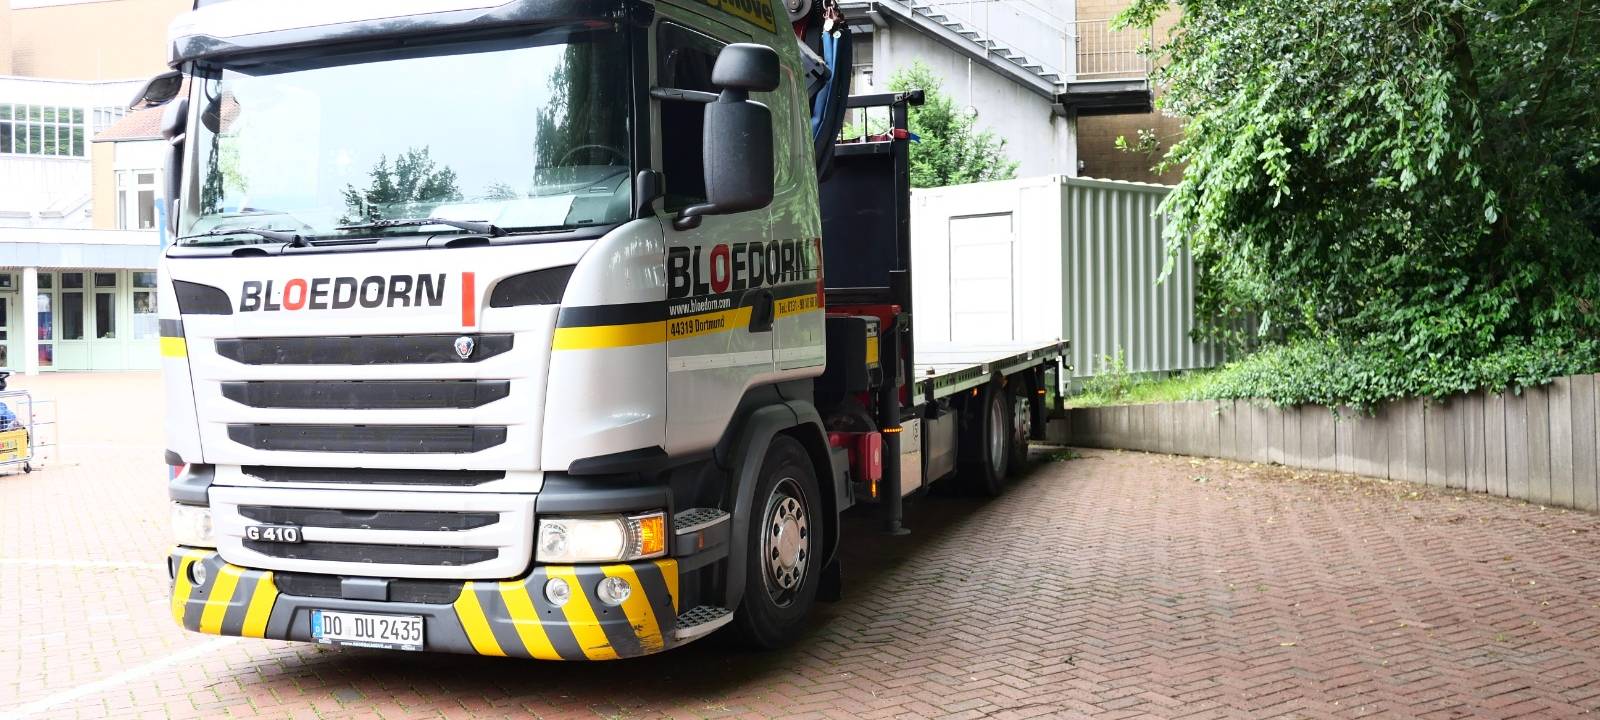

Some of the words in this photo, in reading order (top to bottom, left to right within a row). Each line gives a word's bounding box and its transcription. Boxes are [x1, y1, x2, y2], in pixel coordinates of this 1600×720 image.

[667, 239, 810, 299] BLOEDORN
[239, 273, 447, 312] BLOEDORN
[669, 298, 731, 316] www.bloedorn.com
[671, 320, 694, 336] 44319
[695, 315, 725, 332] Dortmund
[247, 526, 260, 540] G
[263, 527, 297, 542] 410
[323, 615, 342, 636] DO
[355, 617, 375, 639] DU
[380, 619, 421, 641] 2435
